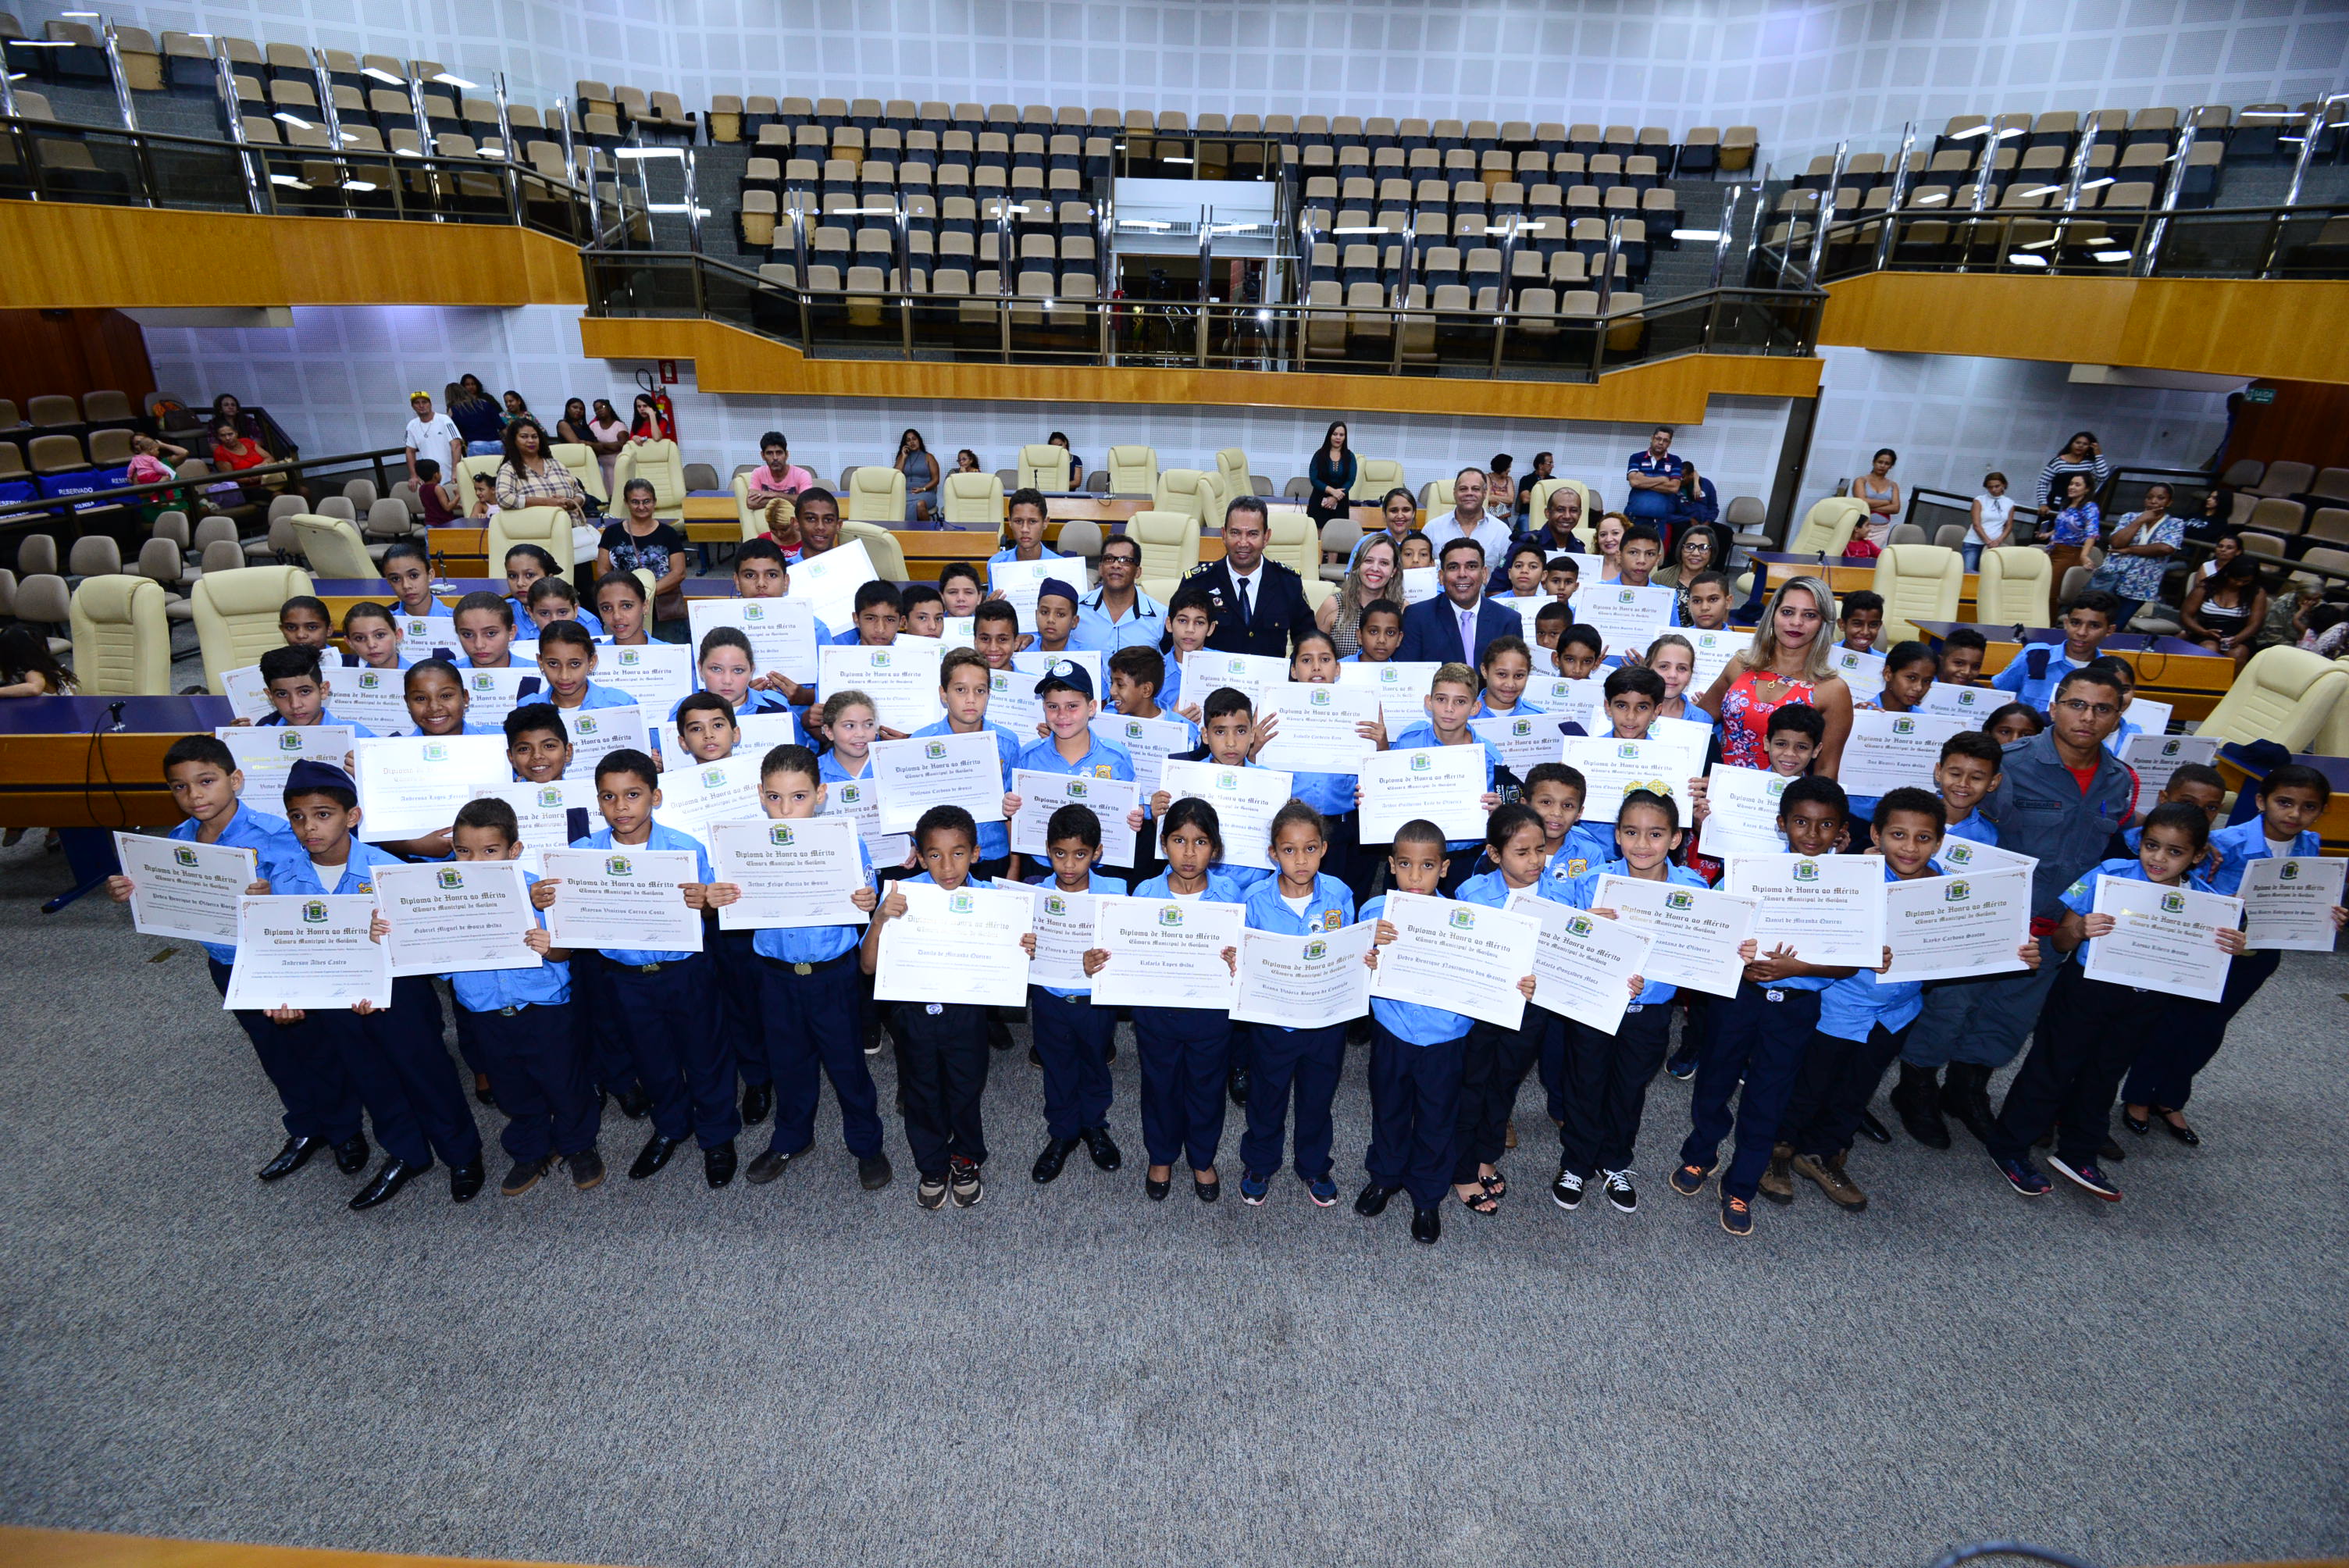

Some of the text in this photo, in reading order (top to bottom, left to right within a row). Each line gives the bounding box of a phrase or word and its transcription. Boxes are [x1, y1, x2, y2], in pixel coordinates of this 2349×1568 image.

[1856, 734, 1883, 743] Diploma
[1892, 736, 1913, 745] Honra
[734, 850, 765, 860] Diploma
[774, 850, 798, 858] Honra
[810, 849, 836, 857] Mérito
[143, 864, 172, 878] Diploma
[171, 868, 180, 876] de
[180, 869, 204, 879] Honra
[213, 875, 237, 884] Mérito
[566, 878, 598, 886] Diploma
[610, 879, 635, 888] Honra
[1752, 885, 1783, 894] Diploma
[1784, 886, 1793, 894] de
[1795, 886, 1820, 894] Honra
[399, 897, 432, 906] Diploma
[443, 893, 469, 902] Honra
[480, 891, 506, 900] Mérito
[437, 903, 467, 911] Municipal
[1905, 910, 1936, 918] Diploma
[1947, 905, 1971, 914] Honra
[1982, 900, 2007, 909] Mérito
[1046, 918, 1067, 927] Honra
[1664, 911, 1689, 922] Honra
[1702, 918, 1730, 929] Mérito
[1913, 916, 1938, 925] Câmara
[1938, 914, 1966, 923] Municipal
[263, 928, 294, 937] Diploma
[343, 927, 368, 935] Mérito
[1119, 928, 1149, 937] Diploma
[1160, 930, 1183, 939] Honra
[1196, 932, 1220, 941] Mérito
[1407, 924, 1437, 939] Diploma
[1449, 931, 1472, 943] Honra
[1485, 940, 1511, 953] Mérito
[1414, 935, 1438, 945] Câmara
[1438, 939, 1468, 951] Municipal
[1552, 933, 1561, 942] de
[1562, 936, 1585, 950] Honra
[1595, 949, 1621, 961] Mérito
[1261, 958, 1292, 971] Diploma
[1304, 962, 1326, 971] Honra
[1335, 953, 1355, 964] Mérito
